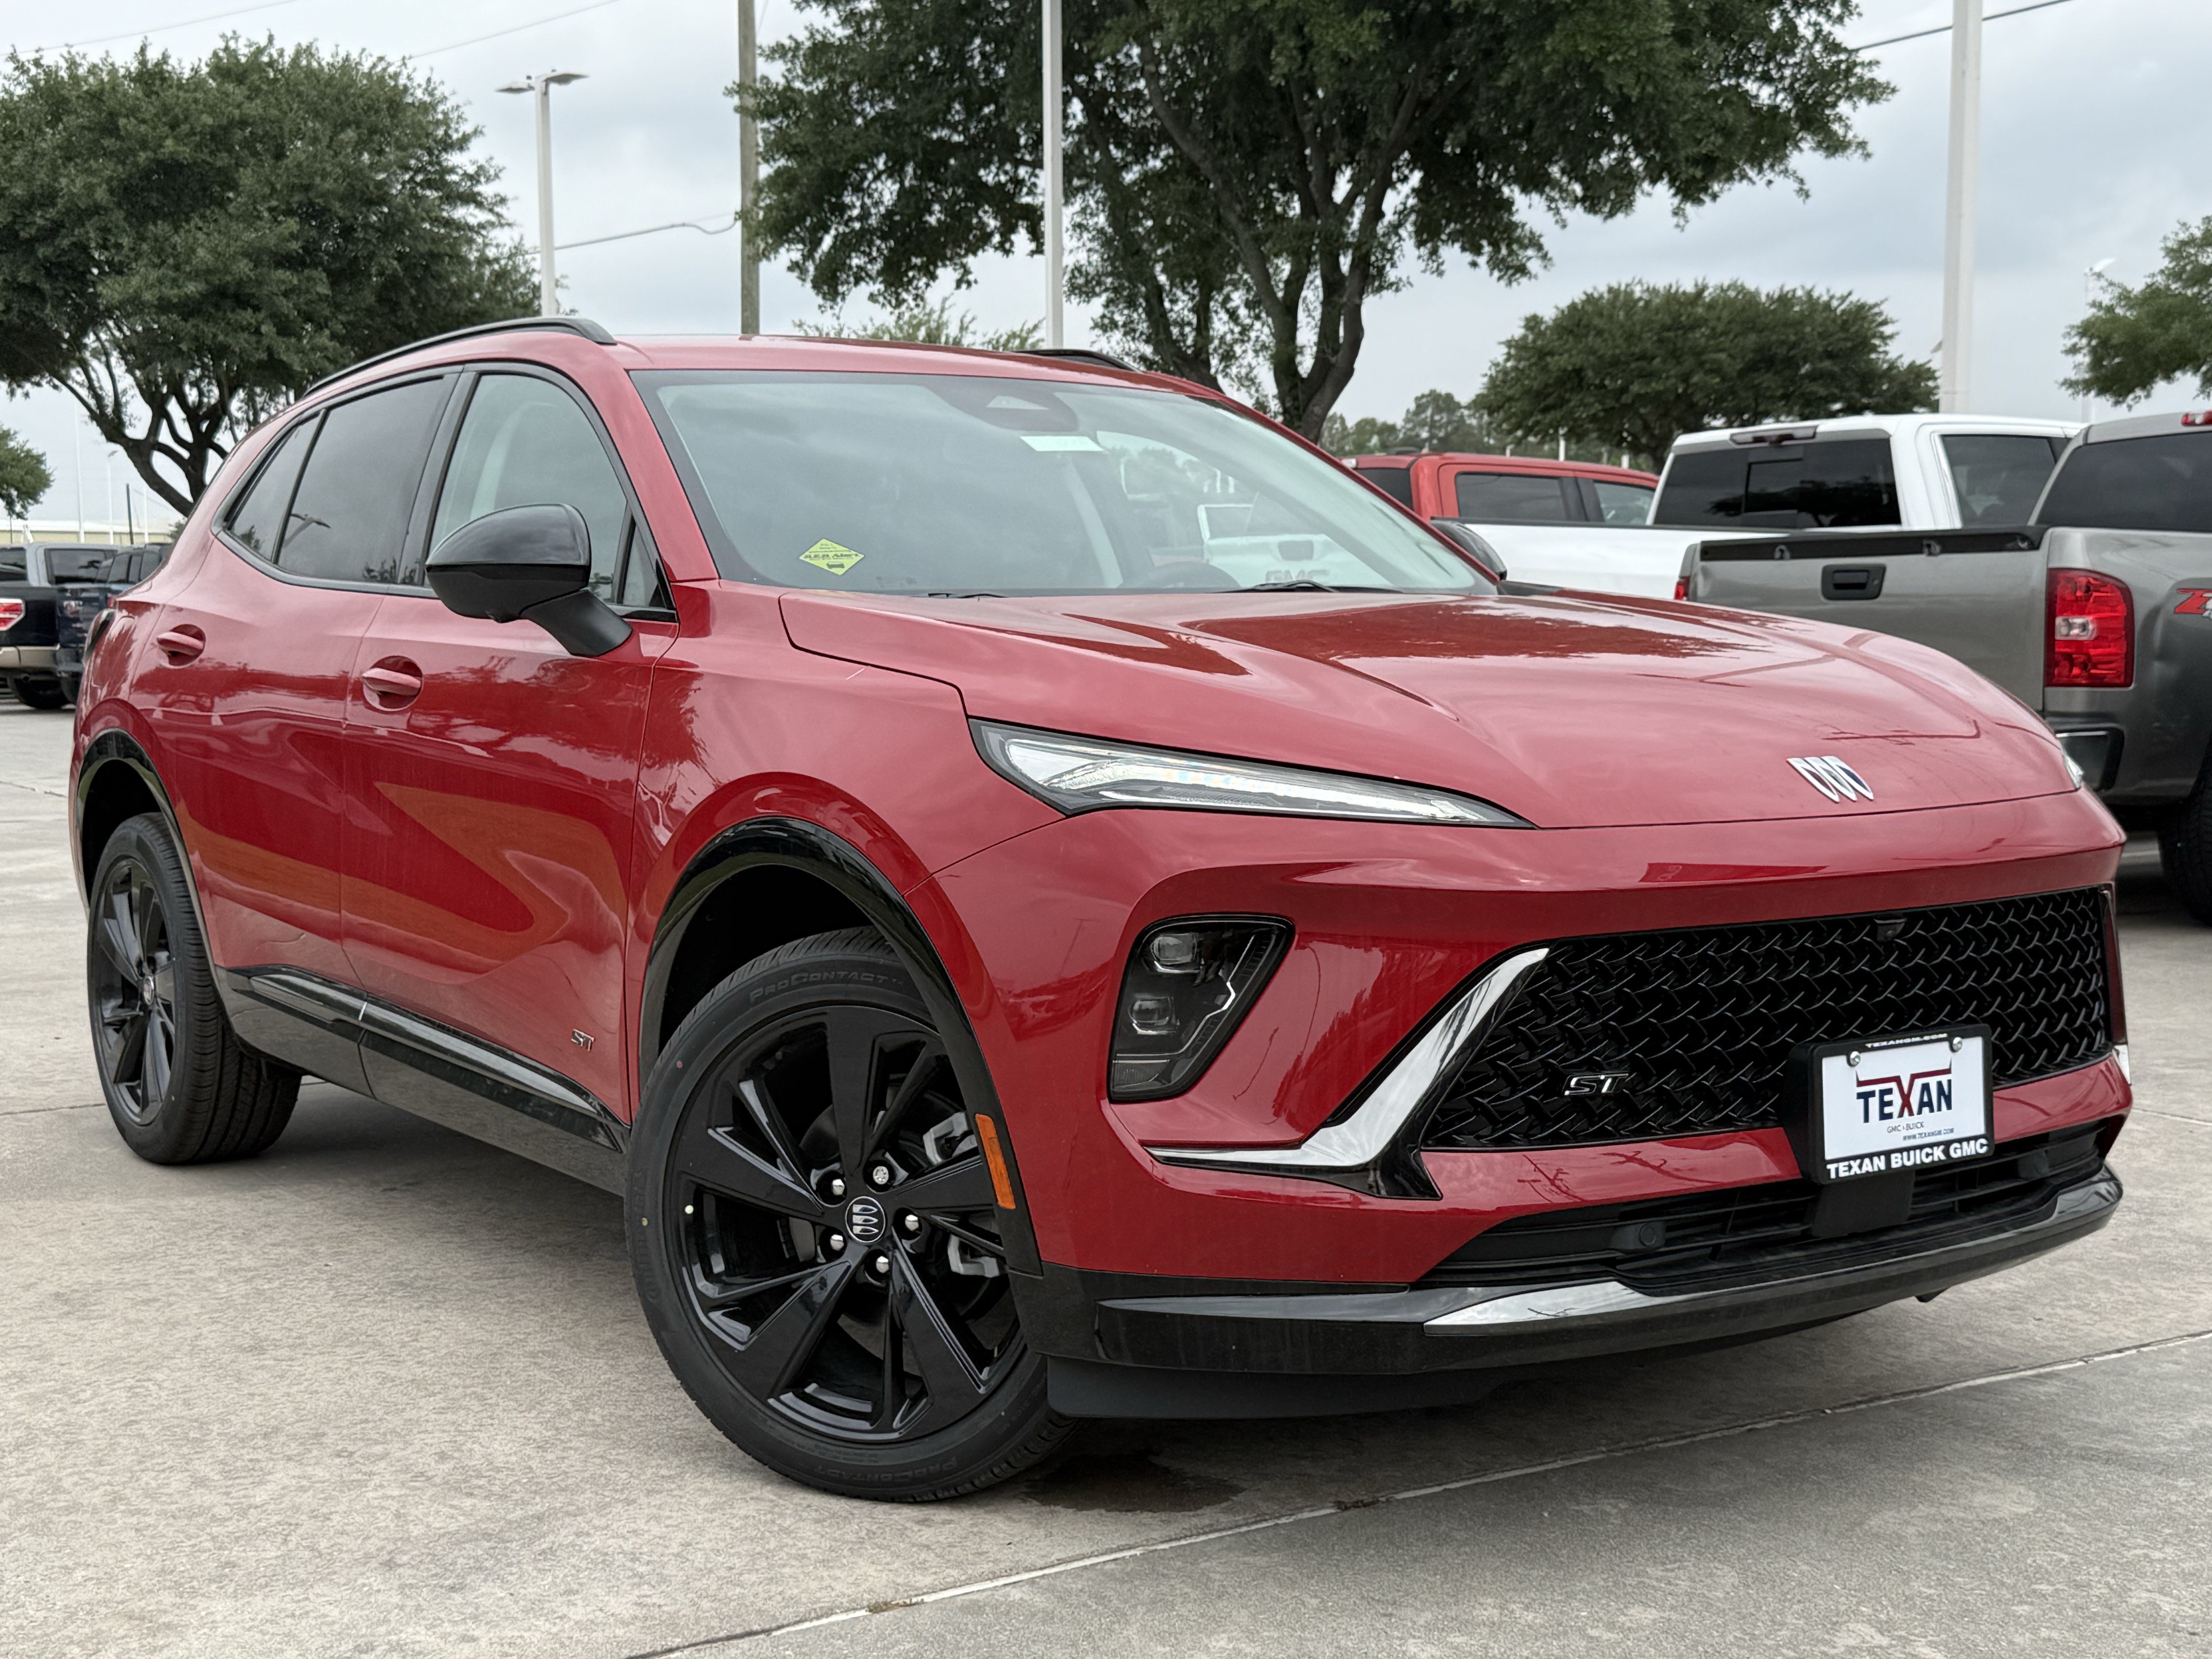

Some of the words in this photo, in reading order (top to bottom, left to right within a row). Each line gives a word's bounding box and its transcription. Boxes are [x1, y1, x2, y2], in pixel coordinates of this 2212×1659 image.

[1856, 1067, 1953, 1123] TEXAN
[1887, 1125, 1901, 1133] GMC
[1826, 1155, 1886, 1179] TEXAN
[1891, 1145, 1946, 1169] BUICK
[1949, 1138, 1988, 1158] GMC
